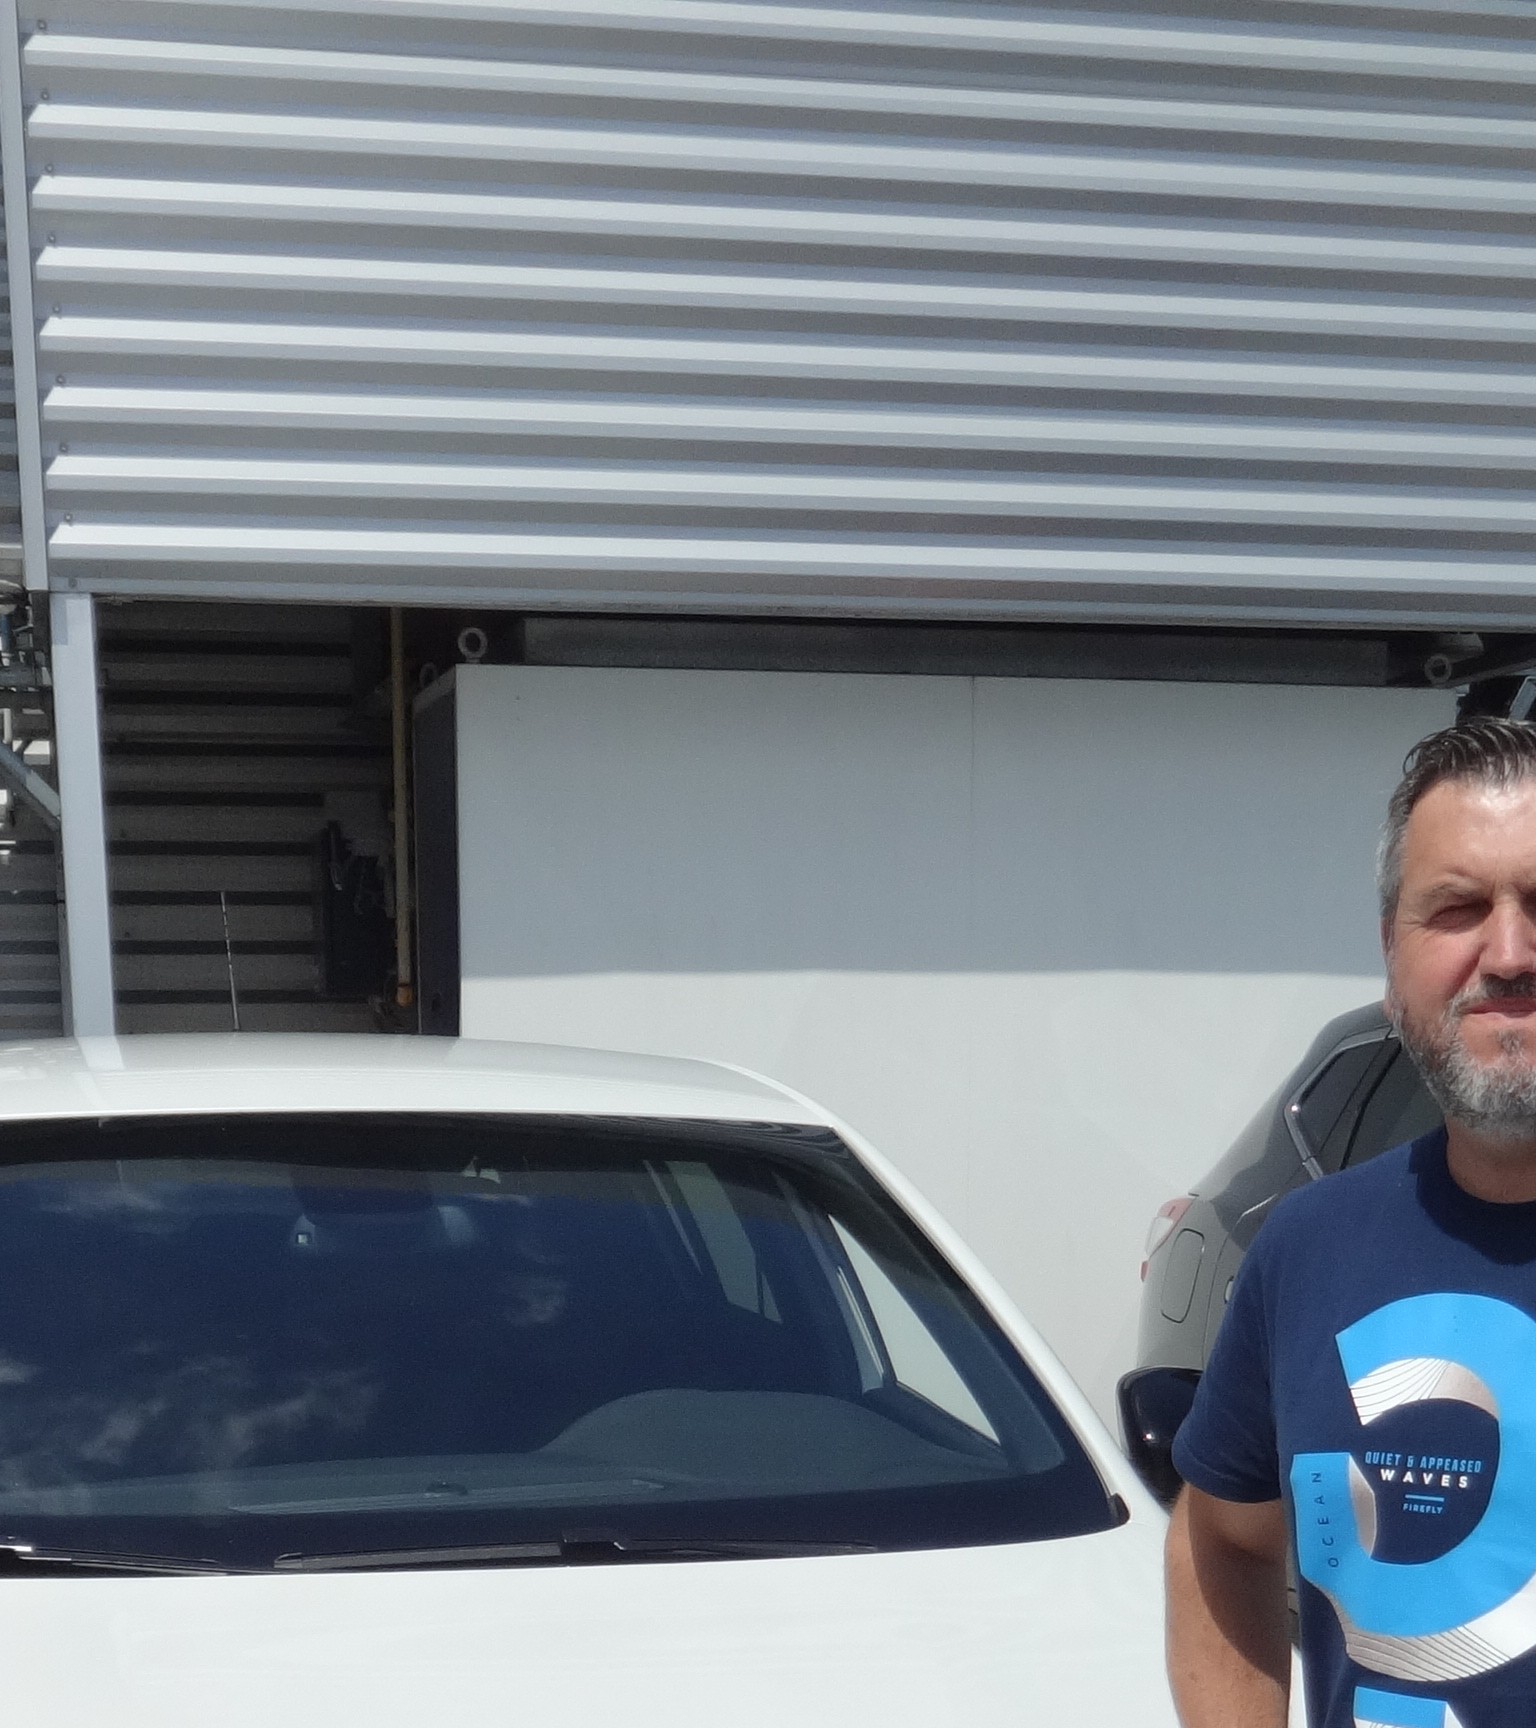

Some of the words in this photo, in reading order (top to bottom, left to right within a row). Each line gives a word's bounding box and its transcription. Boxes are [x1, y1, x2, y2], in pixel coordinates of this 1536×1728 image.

[1365, 1451, 1402, 1466] QUIET
[1407, 1455, 1414, 1467] &
[1420, 1456, 1481, 1473] APPEASED
[1380, 1469, 1468, 1489] WAVES
[1403, 1503, 1444, 1514] FIREFLY
[1312, 1472, 1340, 1568] OCEAN
